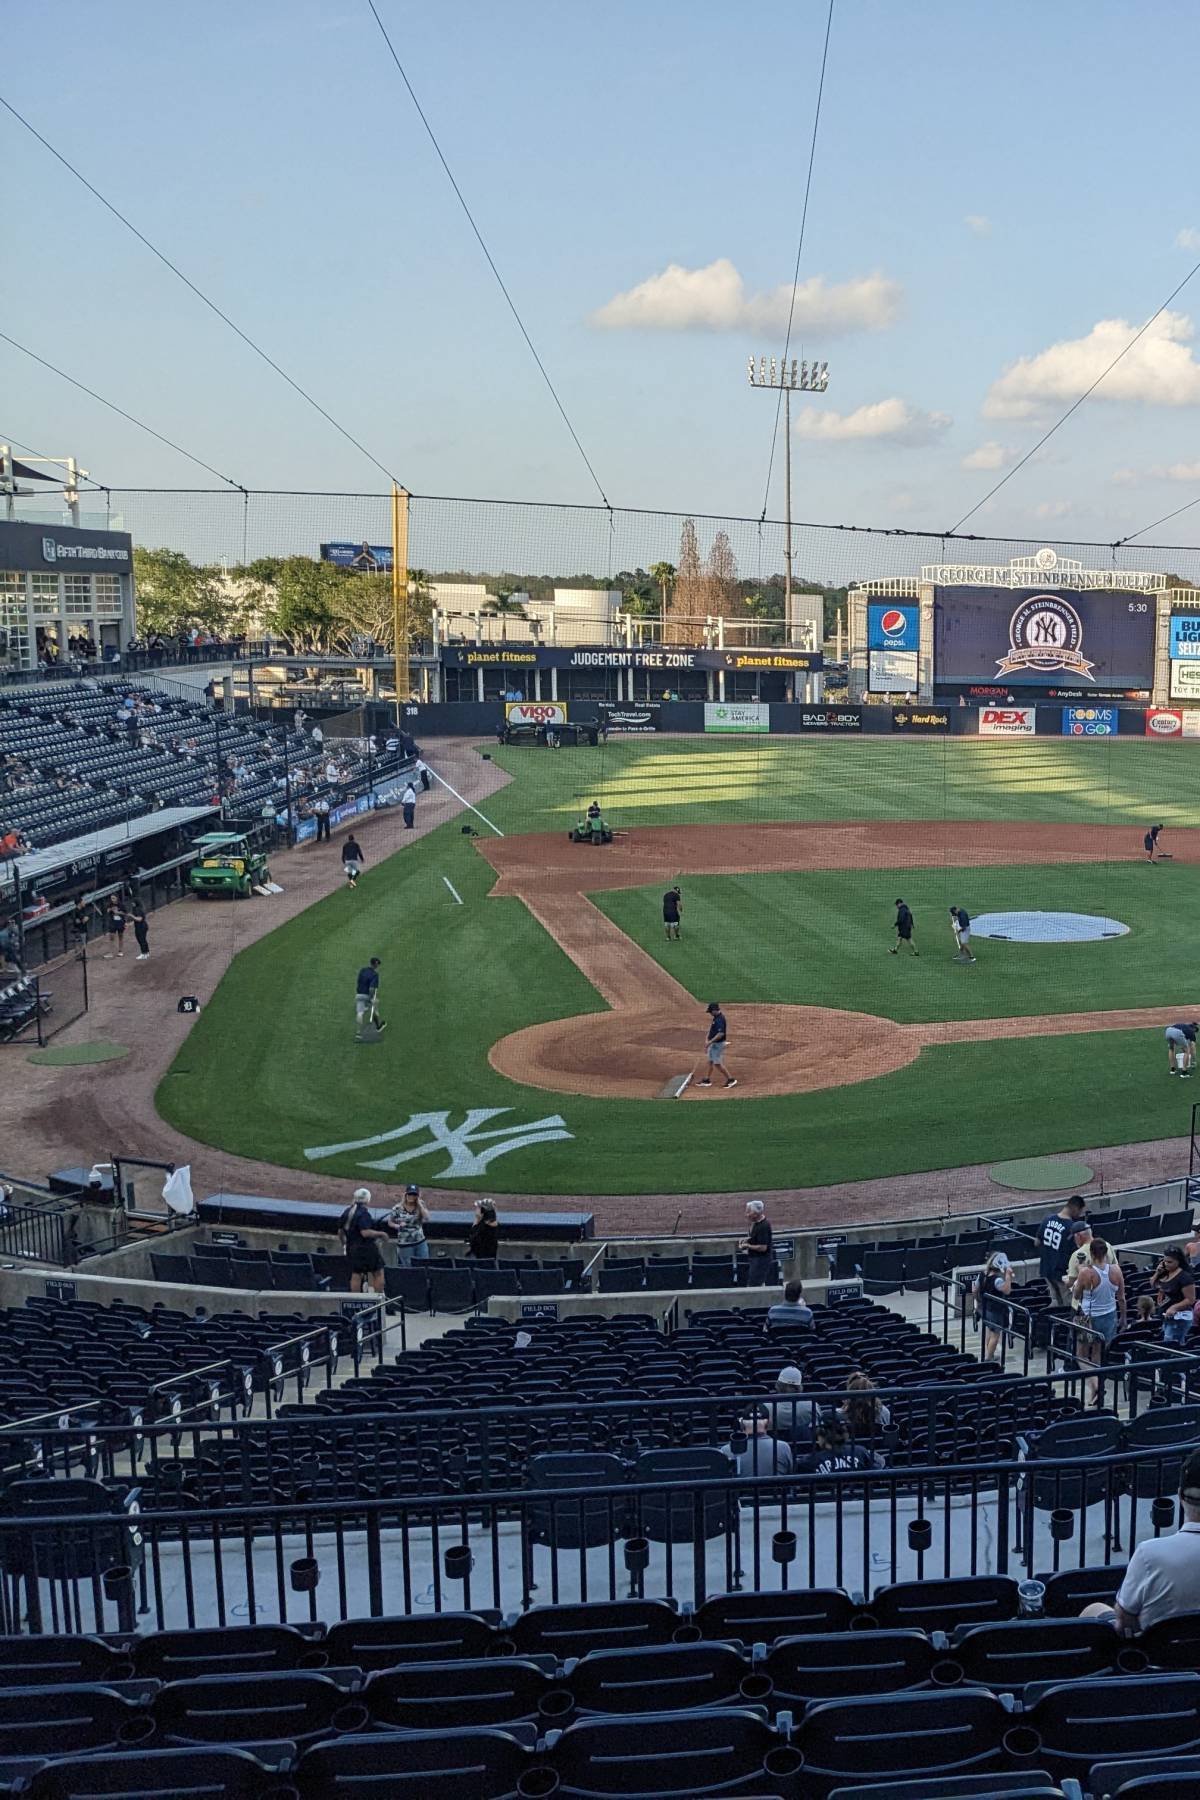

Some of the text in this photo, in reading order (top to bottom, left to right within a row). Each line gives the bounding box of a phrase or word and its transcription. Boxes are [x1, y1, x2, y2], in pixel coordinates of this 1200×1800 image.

[1014, 570, 1111, 586] STEINBRENNER
[1116, 576, 1152, 587] FIELD
[1030, 601, 1075, 626] STEINBRENNER
[1128, 603, 1148, 613] 5:30
[467, 651, 536, 664] planet fitness
[570, 652, 695, 667] JUDGEMENT FREE ZONE
[736, 656, 809, 668] planet fitness
[970, 686, 1008, 696] MORGAN
[1057, 690, 1083, 698] AnyDesk
[1174, 686, 1188, 694] TOY
[405, 706, 418, 716] 318
[982, 710, 1029, 724] DEX
[1068, 709, 1112, 721] ROOMS
[803, 714, 825, 722] BAD
[911, 714, 930, 724] Hard
[930, 715, 948, 725] Rock
[993, 723, 1032, 732] imaging
[1068, 723, 1107, 735] TO GO
[1046, 1220, 1066, 1232] JUDGE
[1043, 1228, 1062, 1250] 99
